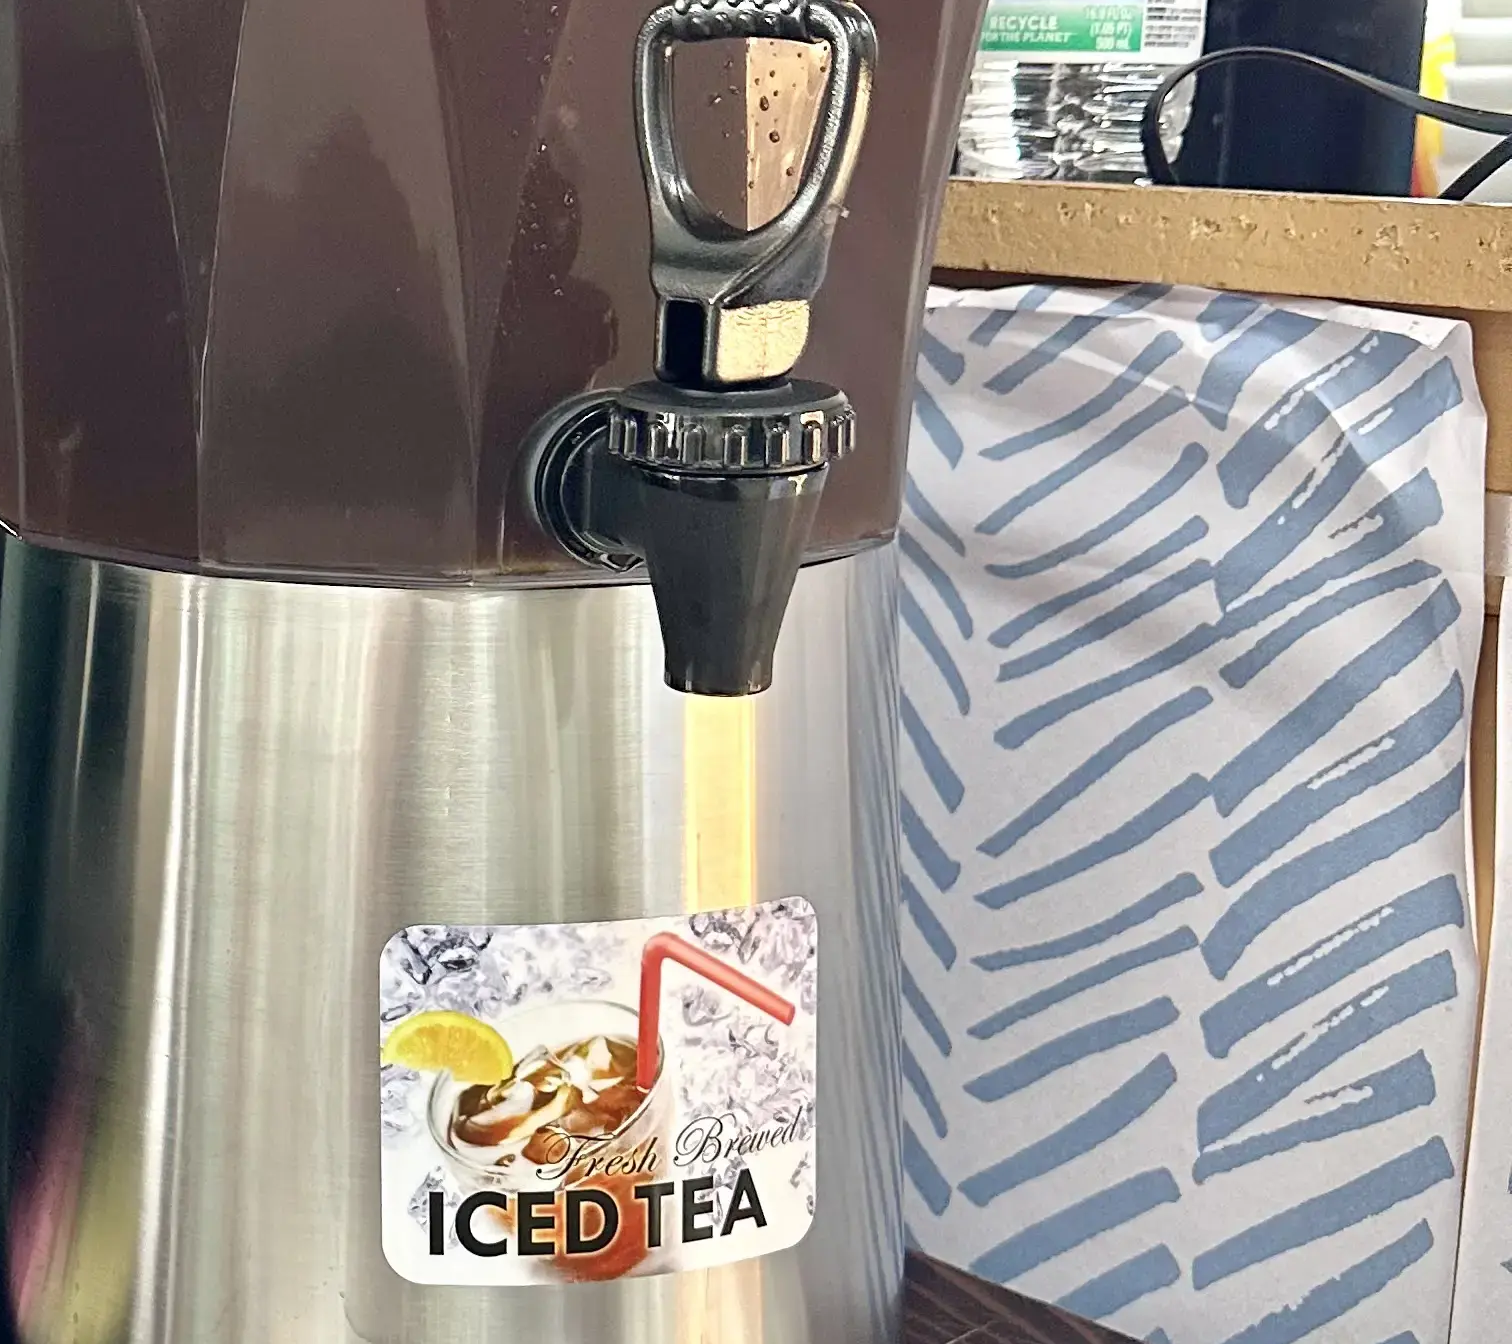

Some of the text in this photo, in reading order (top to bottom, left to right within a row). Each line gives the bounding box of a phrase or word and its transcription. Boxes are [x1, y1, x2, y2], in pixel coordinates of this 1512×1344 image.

[989, 15, 1059, 30] RECYCLE
[1023, 32, 1072, 43] PLANET
[1096, 38, 1114, 50] 500
[535, 1105, 803, 1181] Fresh Brewed
[428, 1168, 768, 1257] ICED TEA
